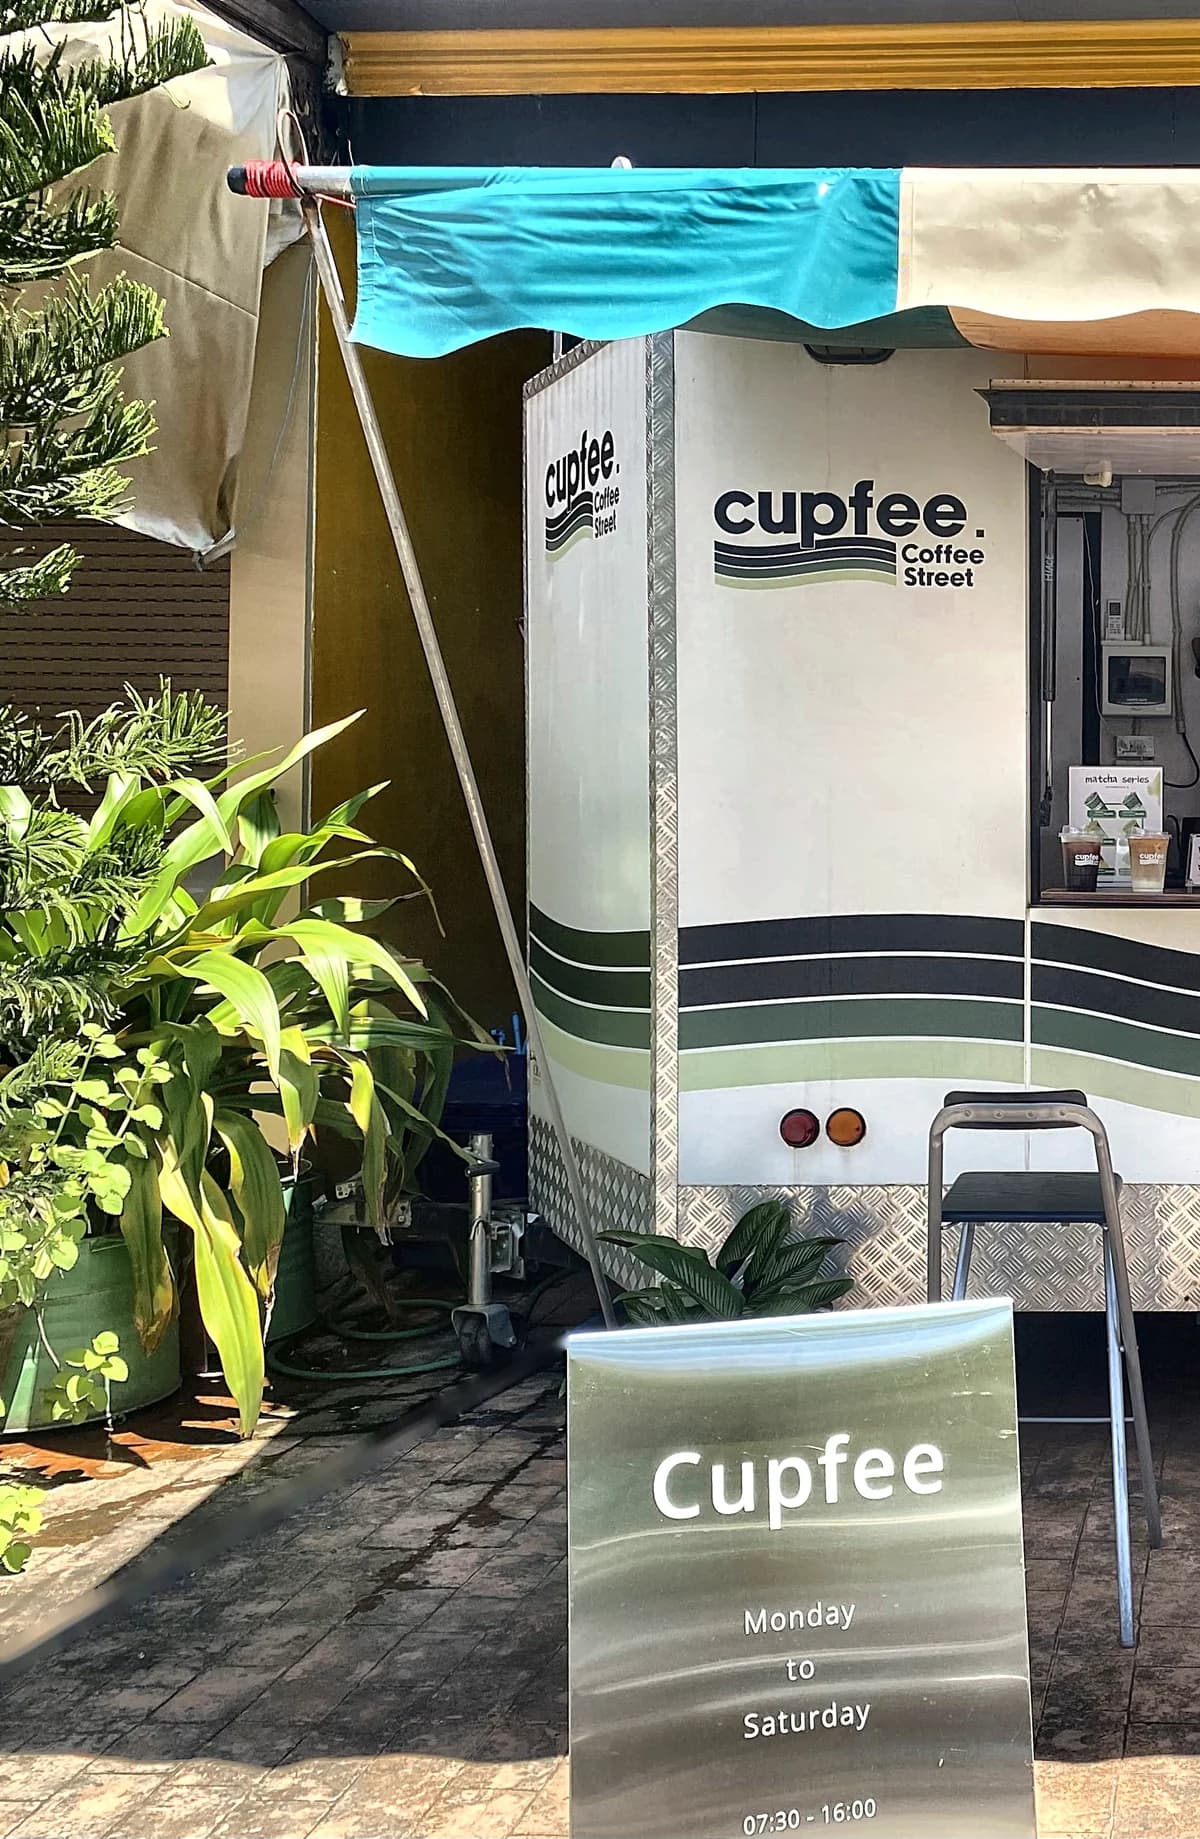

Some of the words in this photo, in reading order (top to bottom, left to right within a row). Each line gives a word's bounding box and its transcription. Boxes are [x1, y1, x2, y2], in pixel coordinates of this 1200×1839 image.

[545, 429, 620, 513] cupfee.
[594, 485, 620, 513] Coffee
[713, 480, 985, 548] cupfee.
[594, 509, 617, 538] Street
[901, 543, 985, 564] Coffee
[904, 567, 974, 587] Street
[1085, 773, 1118, 783] matcha
[652, 1433, 944, 1530] Cupfee
[743, 1600, 857, 1635] Monday
[785, 1657, 815, 1681] to
[743, 1701, 871, 1739] Saturday
[743, 1810, 801, 1836] 07:30
[820, 1799, 877, 1825] 16:00
